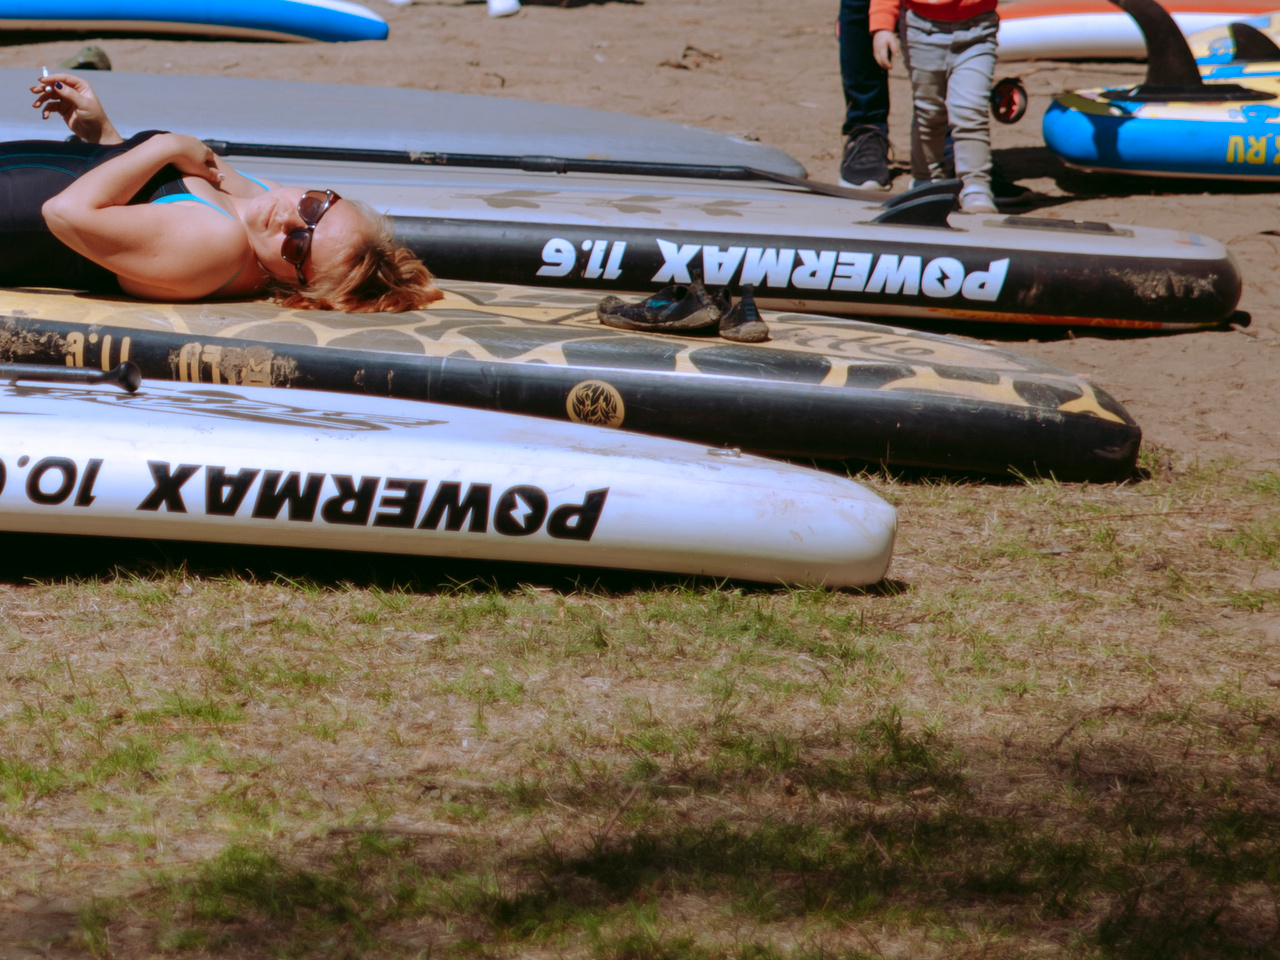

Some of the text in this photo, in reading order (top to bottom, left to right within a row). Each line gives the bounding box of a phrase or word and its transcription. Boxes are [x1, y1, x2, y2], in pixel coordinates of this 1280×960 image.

[535, 237, 1011, 302] POWERMAX 11.6
[136, 460, 611, 542] POWERMAX
